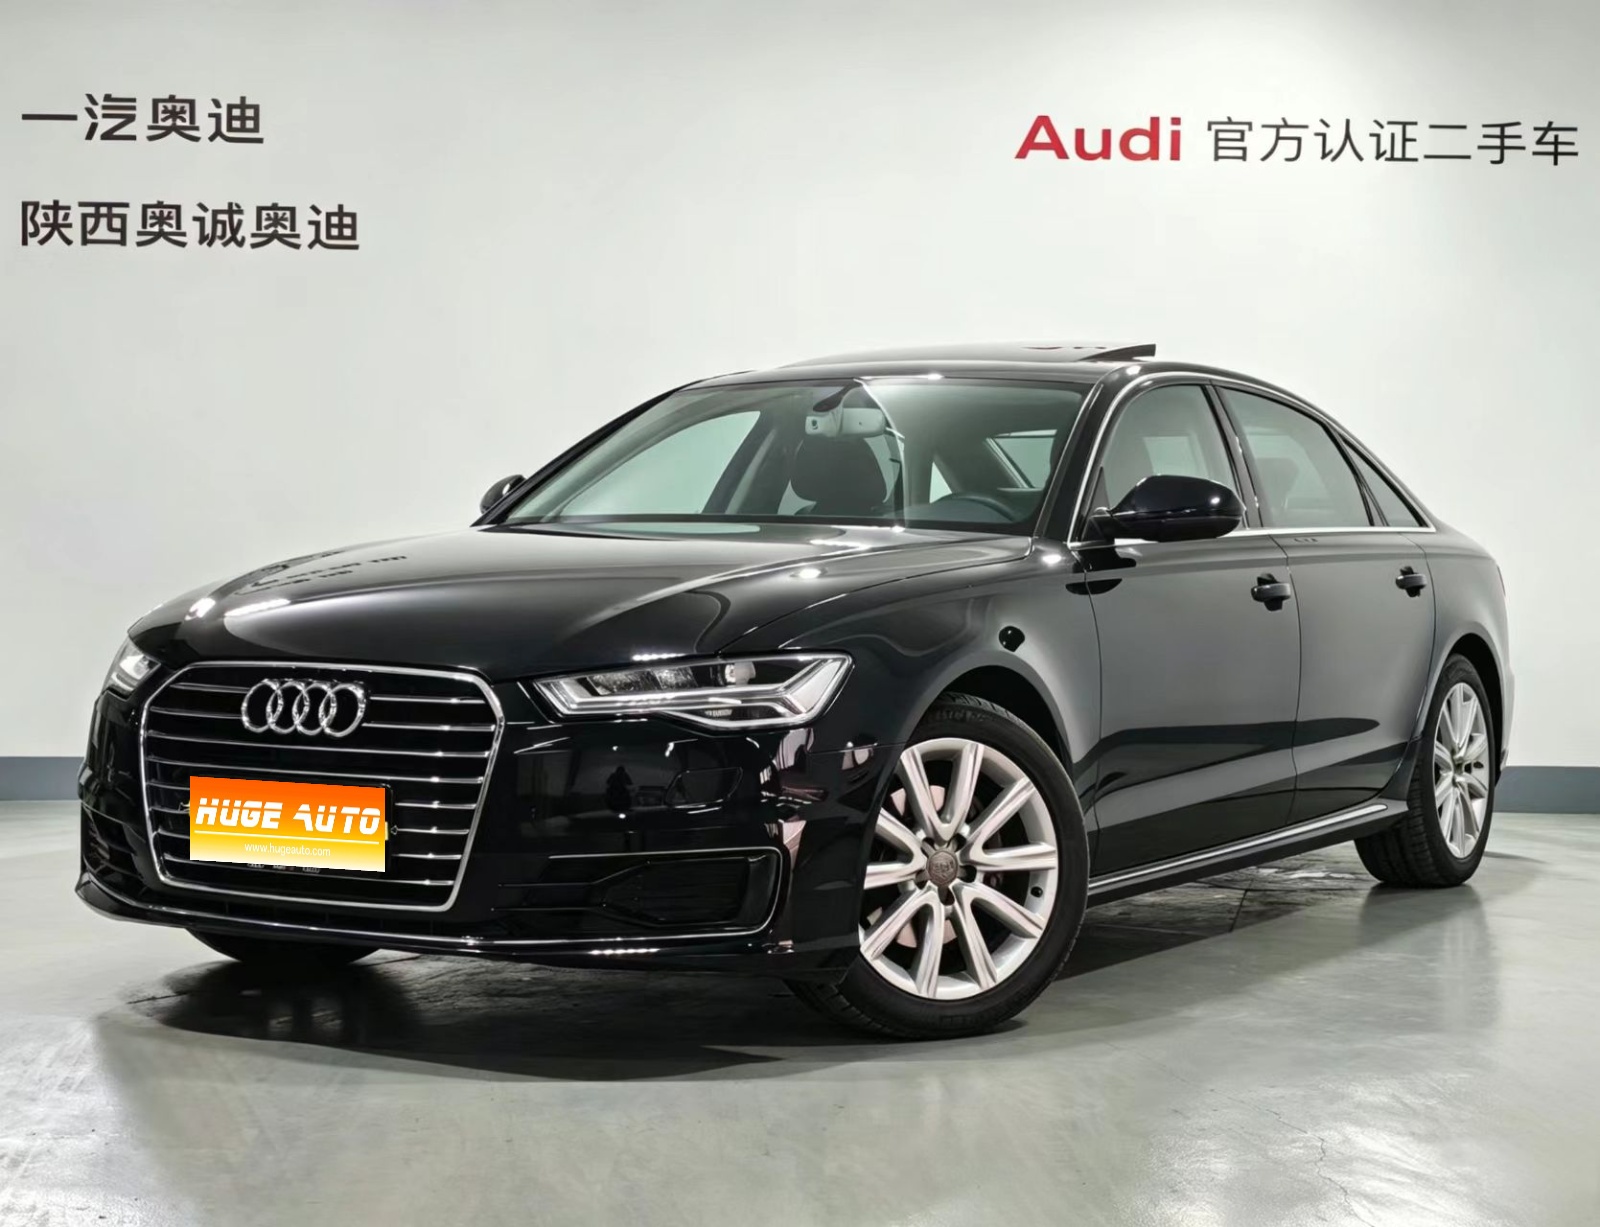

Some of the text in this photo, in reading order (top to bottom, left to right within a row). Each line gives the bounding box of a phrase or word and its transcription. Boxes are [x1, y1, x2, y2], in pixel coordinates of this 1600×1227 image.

[21, 93, 265, 144] 一汽奥迪
[1014, 115, 1579, 166] Audi 官方认证二手车
[21, 199, 360, 250] 陕西奥诚奥迪
